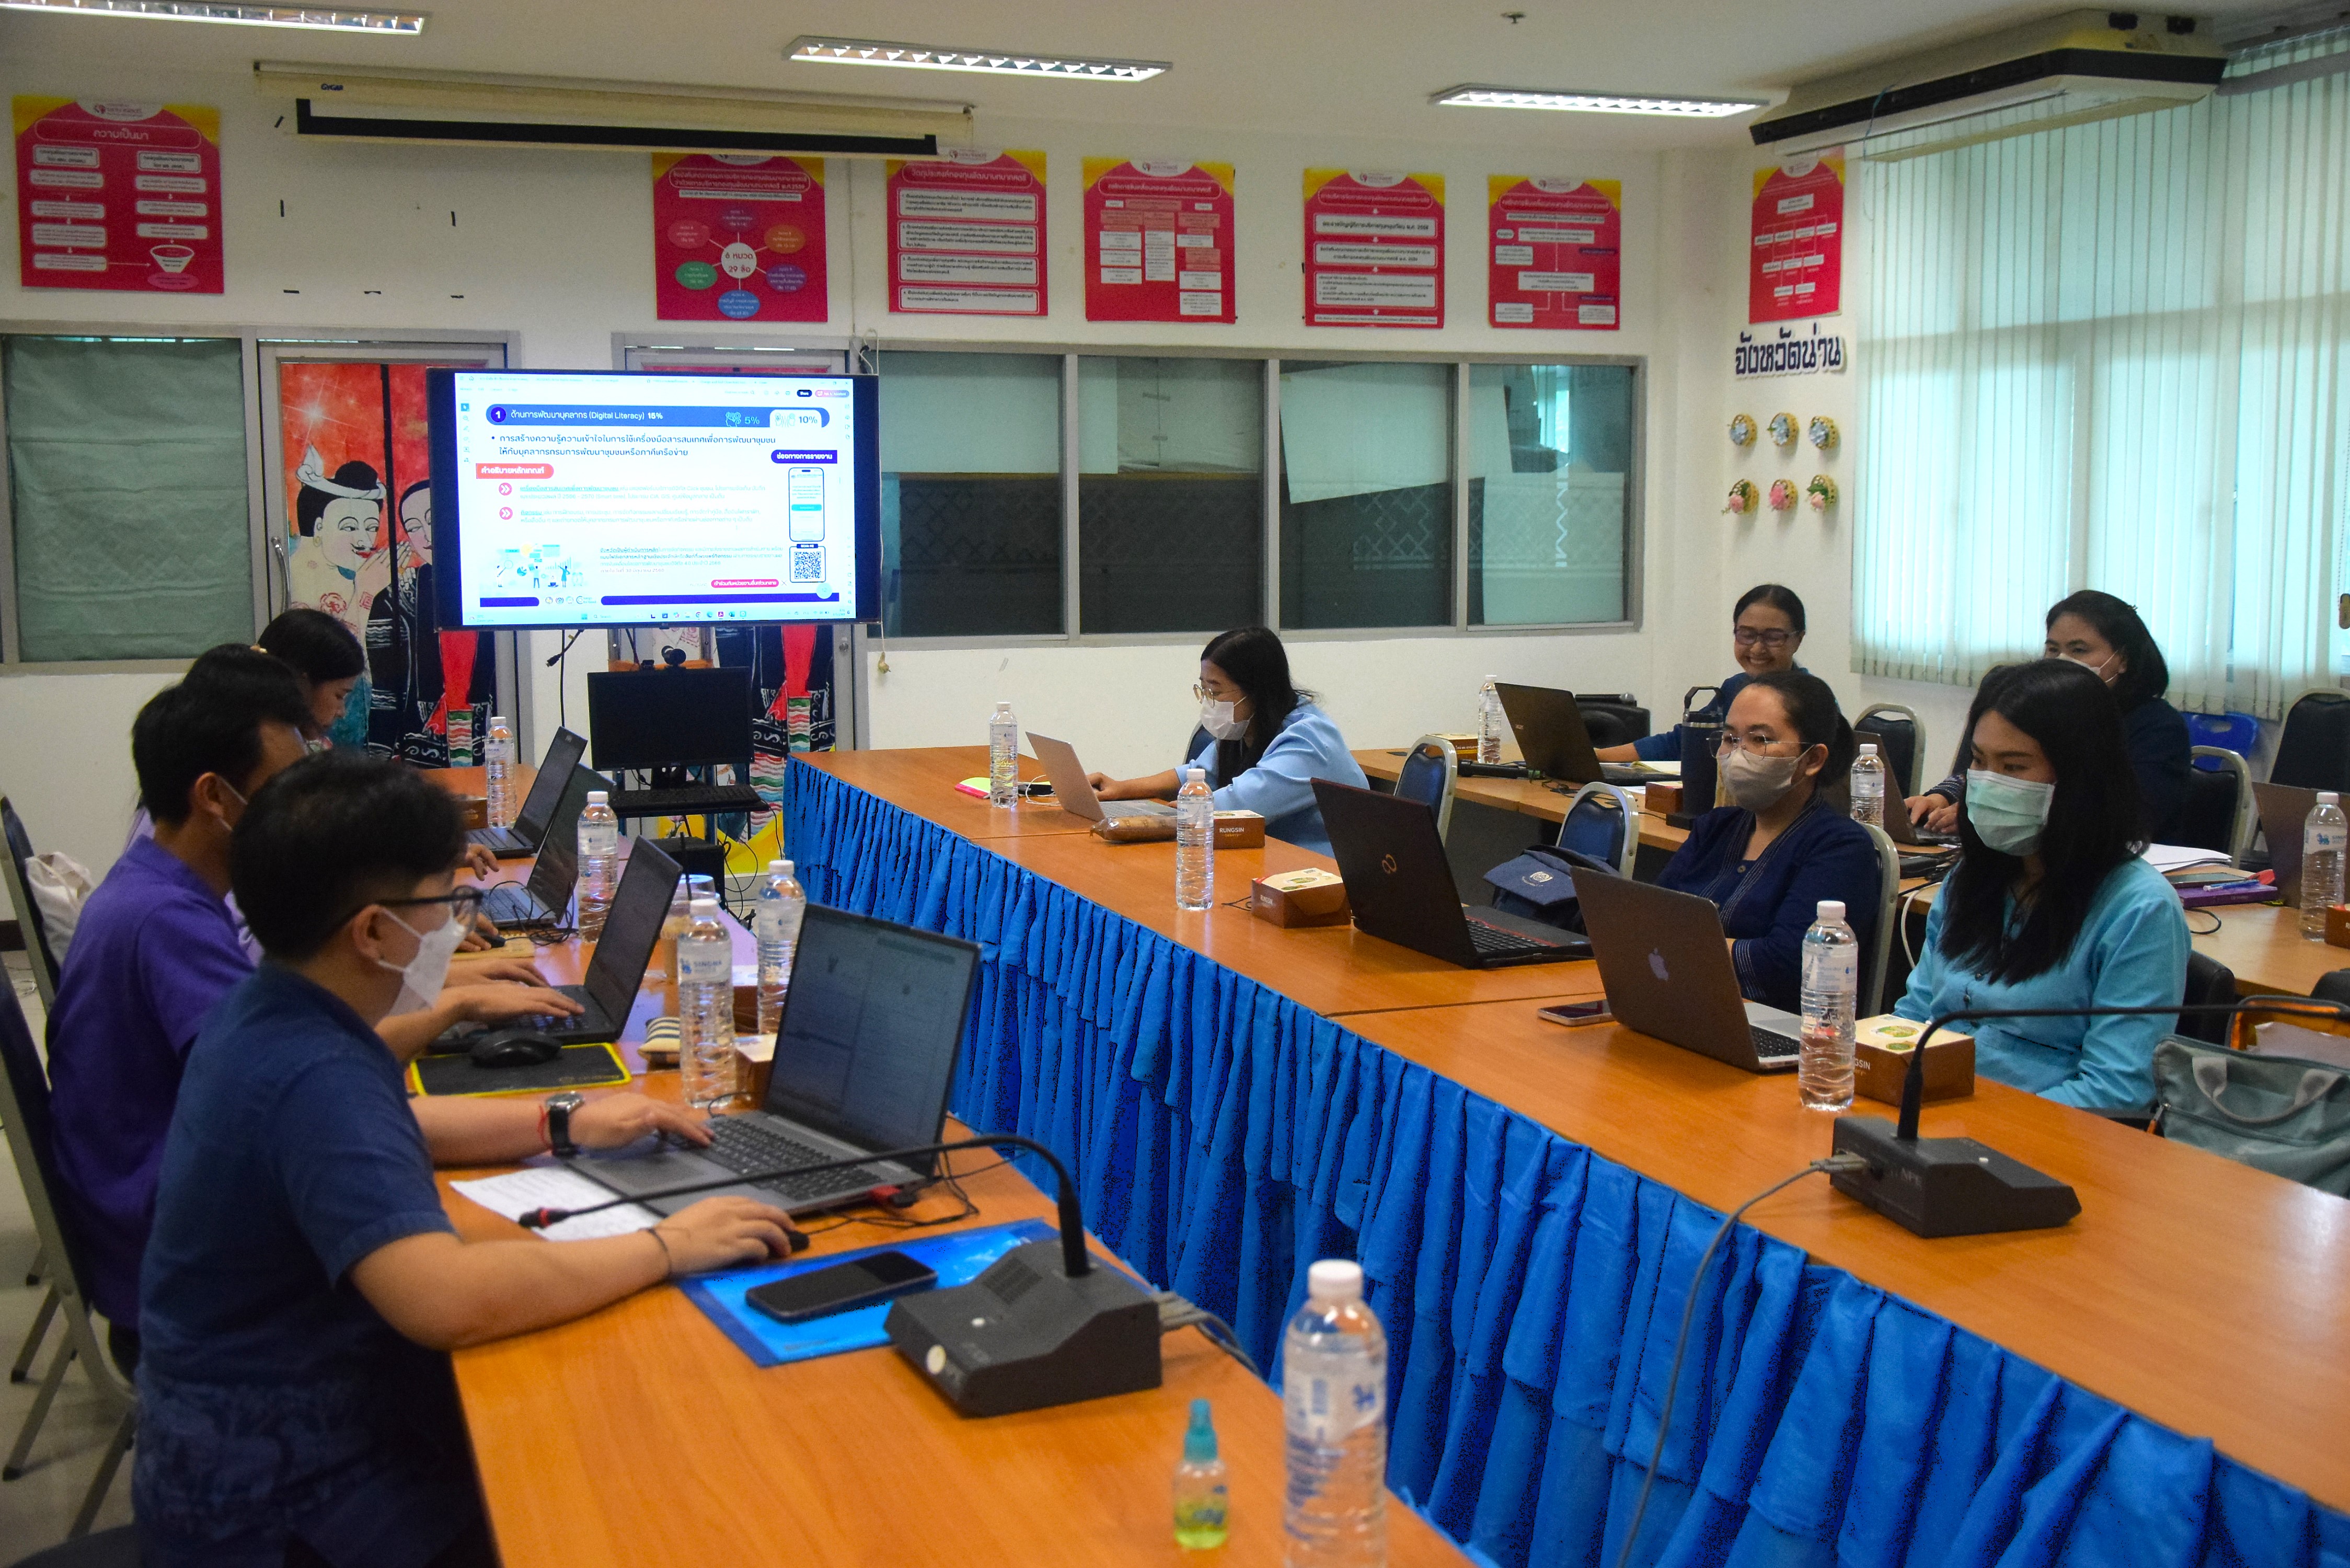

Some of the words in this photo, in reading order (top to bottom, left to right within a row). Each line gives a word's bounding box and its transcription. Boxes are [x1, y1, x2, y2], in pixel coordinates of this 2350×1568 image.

[93, 128, 149, 140] ความเป็นมา
[1735, 322, 1841, 375] จังหวัดน่าน
[496, 410, 501, 419] 1
[511, 410, 588, 420] ด้านการพัฒนาบุคลากร
[590, 411, 613, 420] (Digital
[615, 412, 645, 420] Literacy)
[500, 433, 776, 445] การสร้างความรู้ความเข้าใจในการใช้เครื่องมือสารสนเทศเพื่อการพัฒนาชุมชน
[499, 447, 688, 457] ให้กับบุคลากรกรมการพัฒนาชุมชนหรือภาคีเครือข่าย
[1854, 1058, 1870, 1070] GSIN
